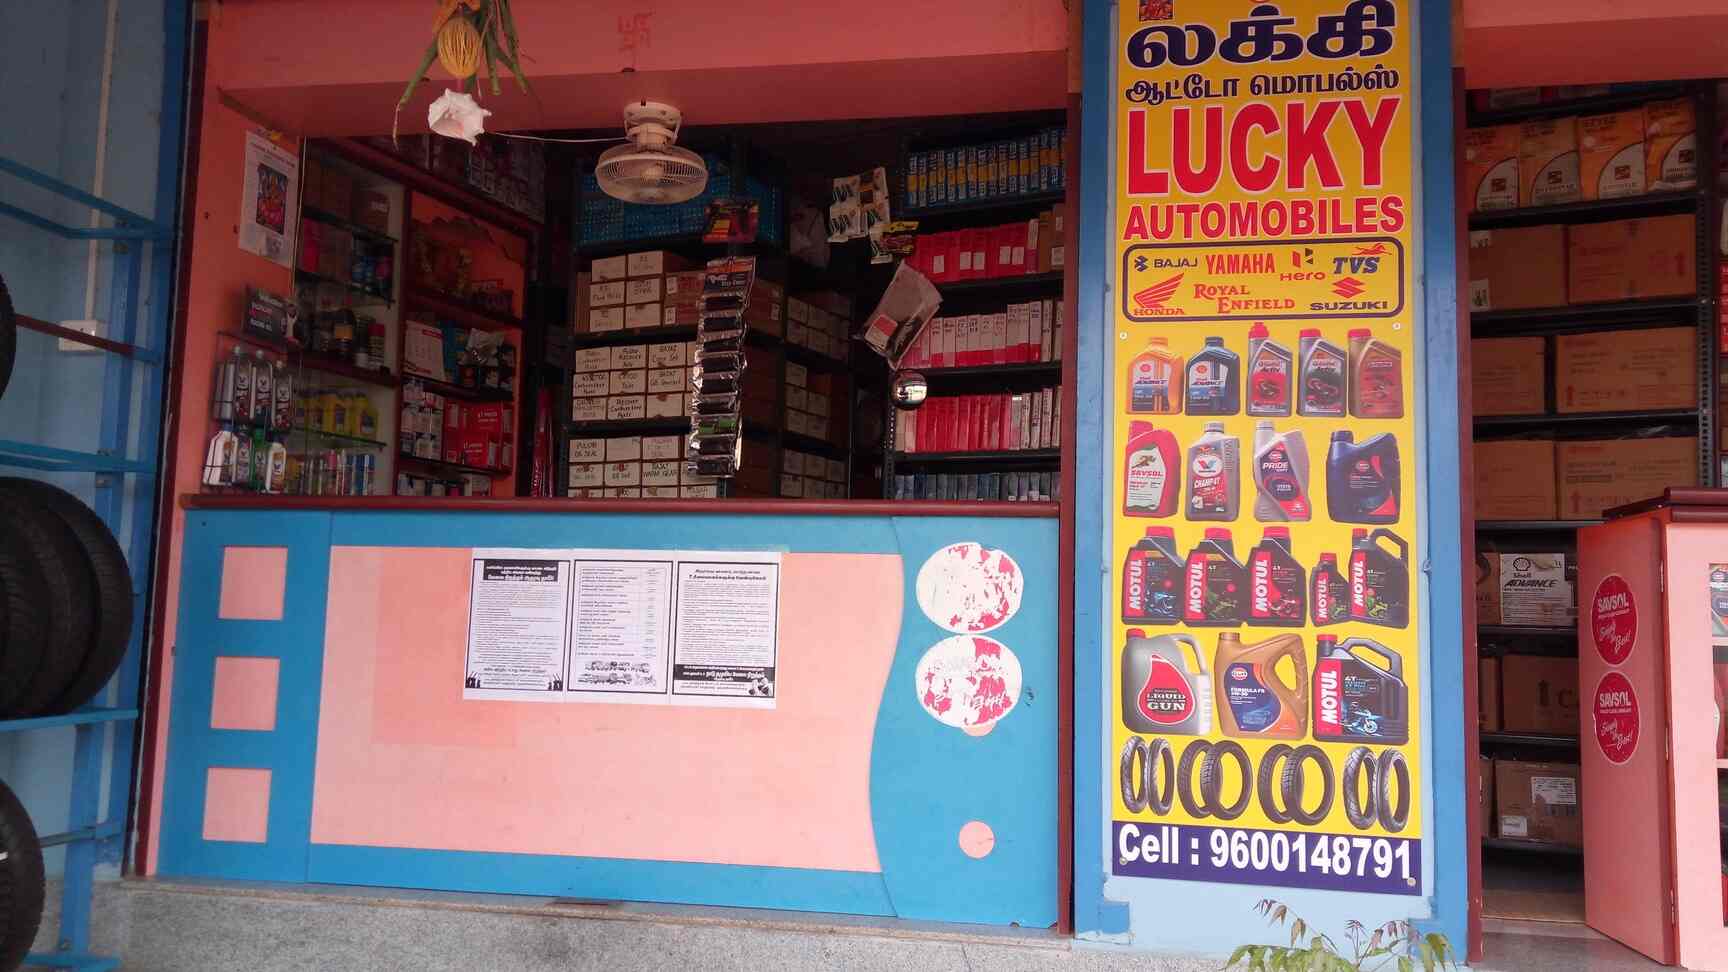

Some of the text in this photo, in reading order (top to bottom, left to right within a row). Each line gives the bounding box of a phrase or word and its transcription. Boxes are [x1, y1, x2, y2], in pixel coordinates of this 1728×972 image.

[1127, 0, 1396, 68] லக்கி
[1125, 74, 1240, 106] ஆட்டோ
[1127, 98, 1401, 195] LUCKY
[1123, 196, 1404, 241] AUTOMOBILES
[1153, 257, 1198, 268] BAJAJ
[1205, 253, 1276, 275] YAMAHA
[1333, 256, 1380, 275] TVS
[1133, 307, 1185, 317] HONDA
[1310, 301, 1388, 311] SUZUKI
[1129, 559, 1142, 610] MOTUL
[1189, 562, 1203, 613] MOTUL
[1255, 559, 1268, 612] MOTUL
[1318, 578, 1327, 619] MOTUL
[1353, 560, 1364, 607] MOTUL
[1598, 593, 1630, 612] SAVSOL
[1146, 702, 1185, 711] GUN
[1321, 670, 1338, 725] MOTUL
[1600, 691, 1632, 706] SAVSOL
[1119, 823, 1179, 865] Cell
[1210, 829, 1411, 880] 9600148791
